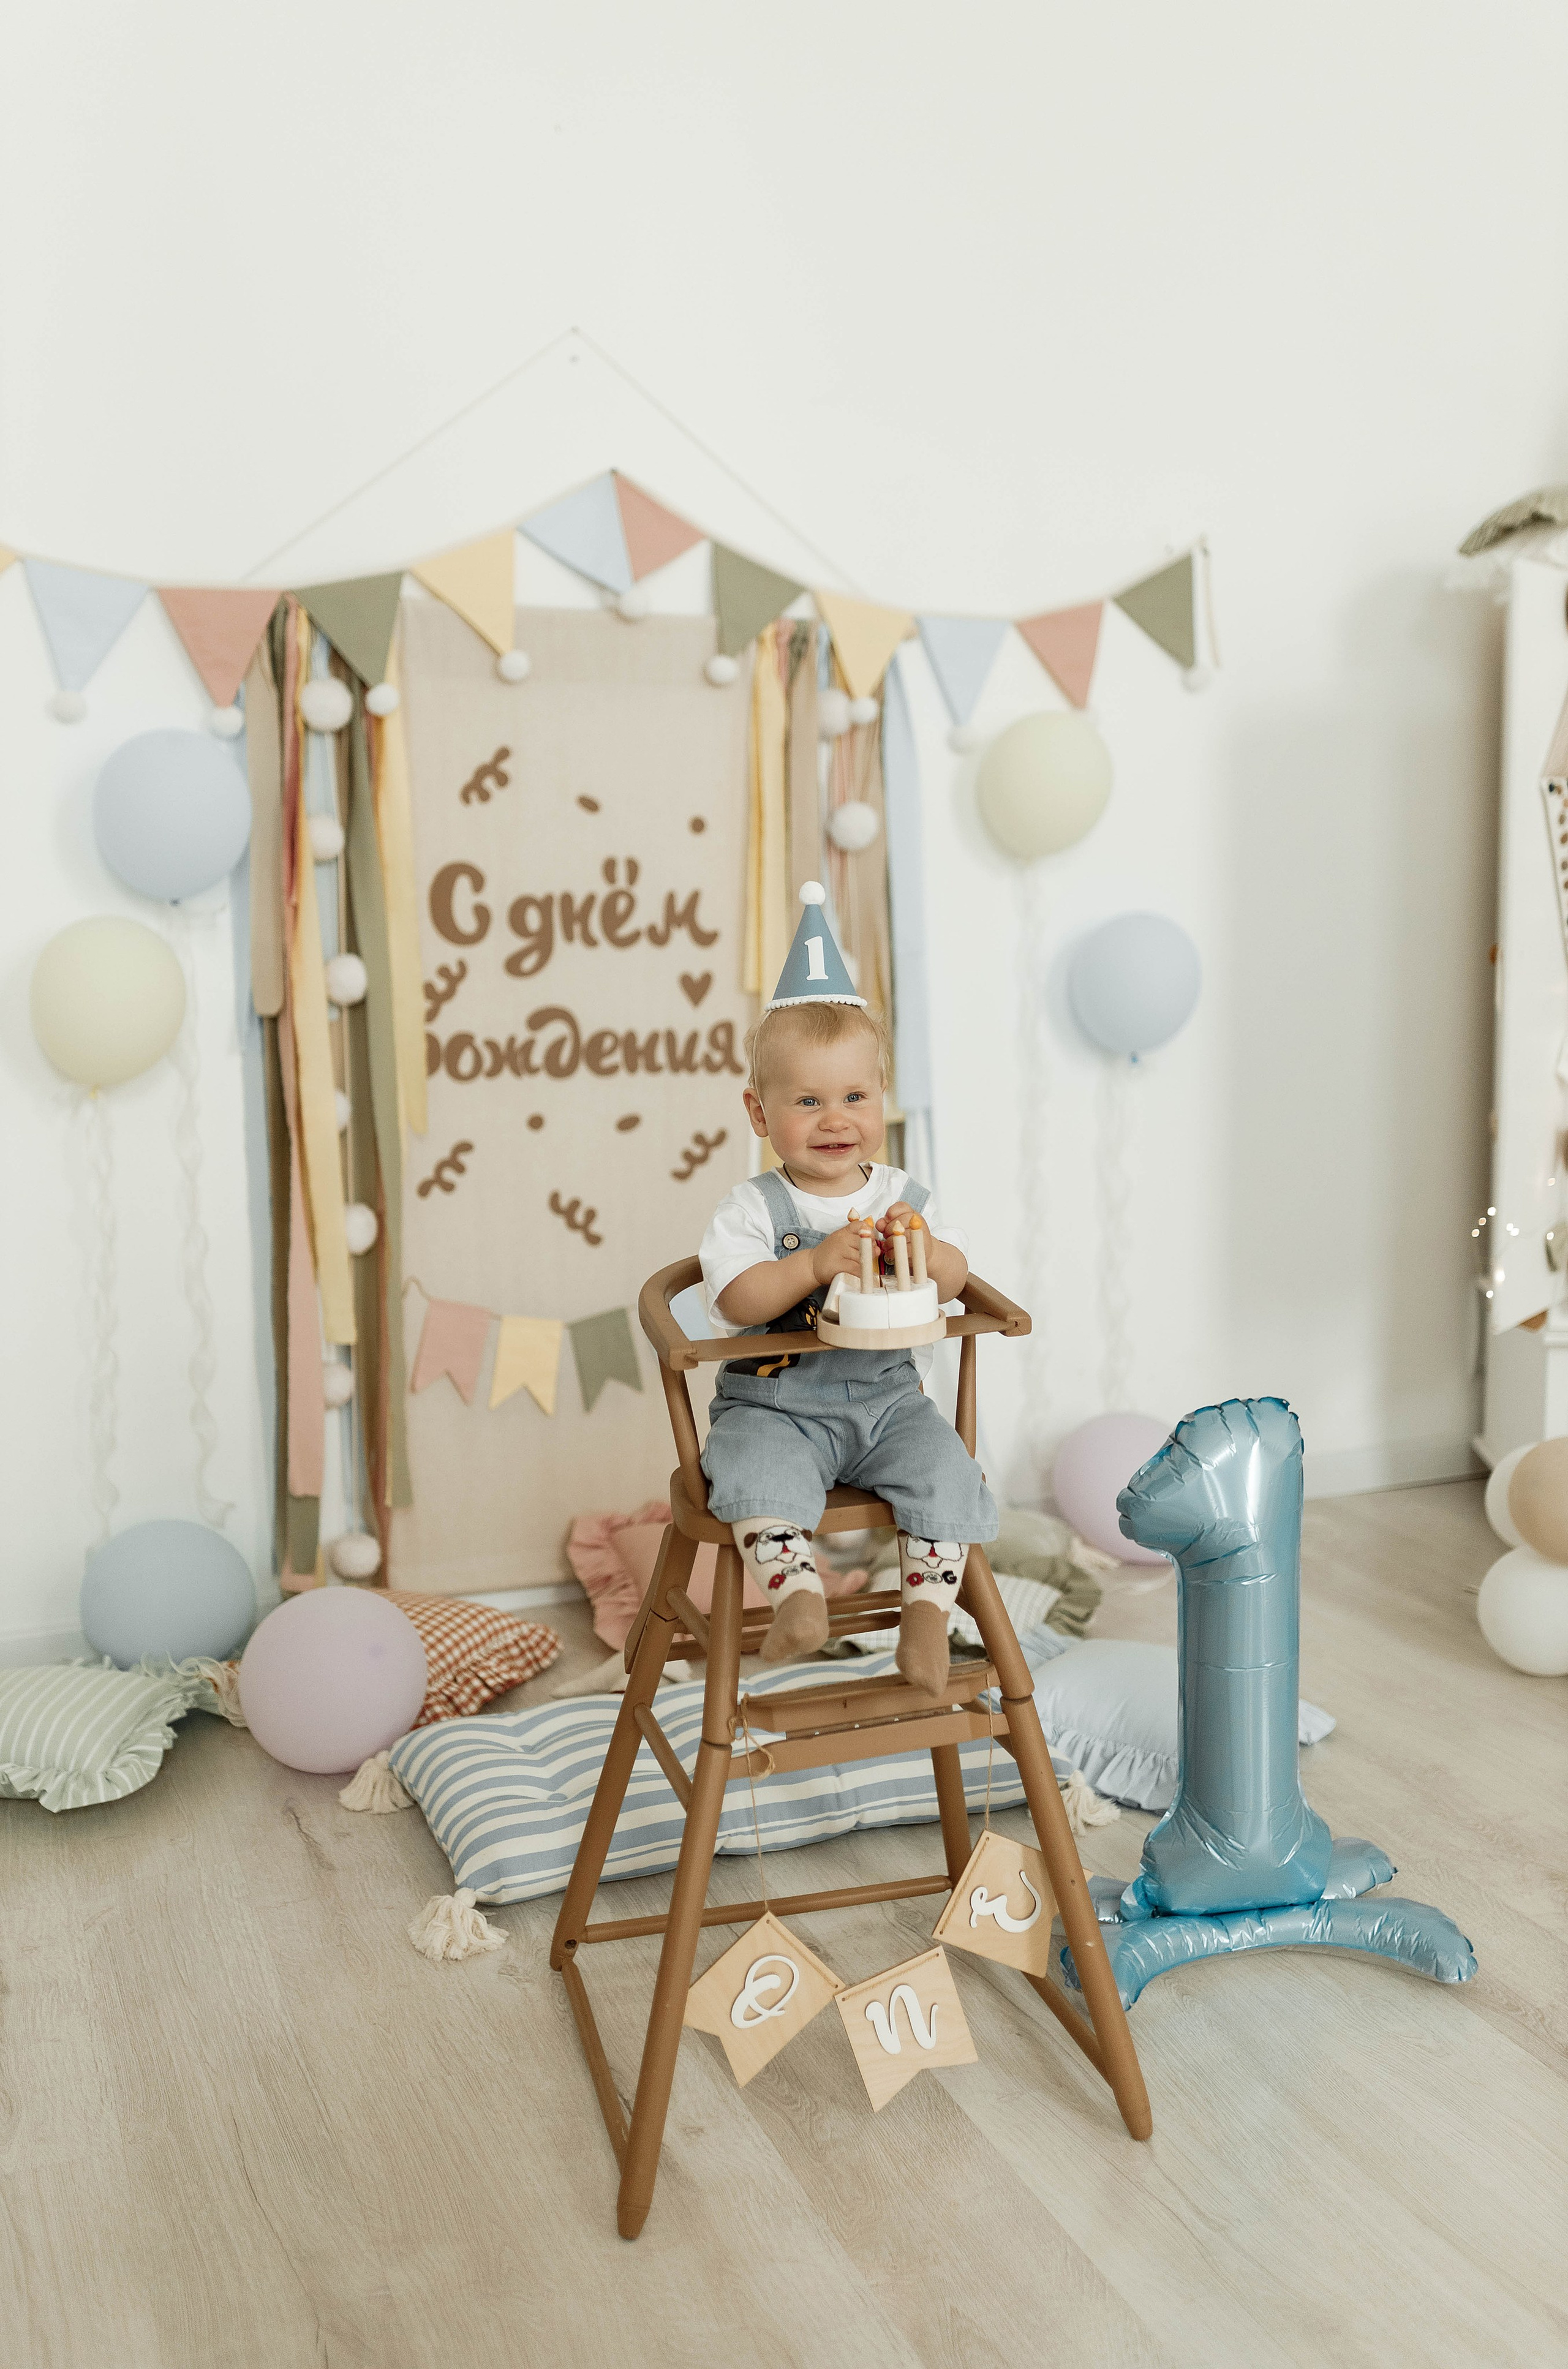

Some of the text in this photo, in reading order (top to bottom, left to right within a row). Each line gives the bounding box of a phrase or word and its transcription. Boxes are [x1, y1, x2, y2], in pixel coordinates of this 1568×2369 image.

[429, 856, 720, 979] С днём
[804, 935, 829, 981] 1
